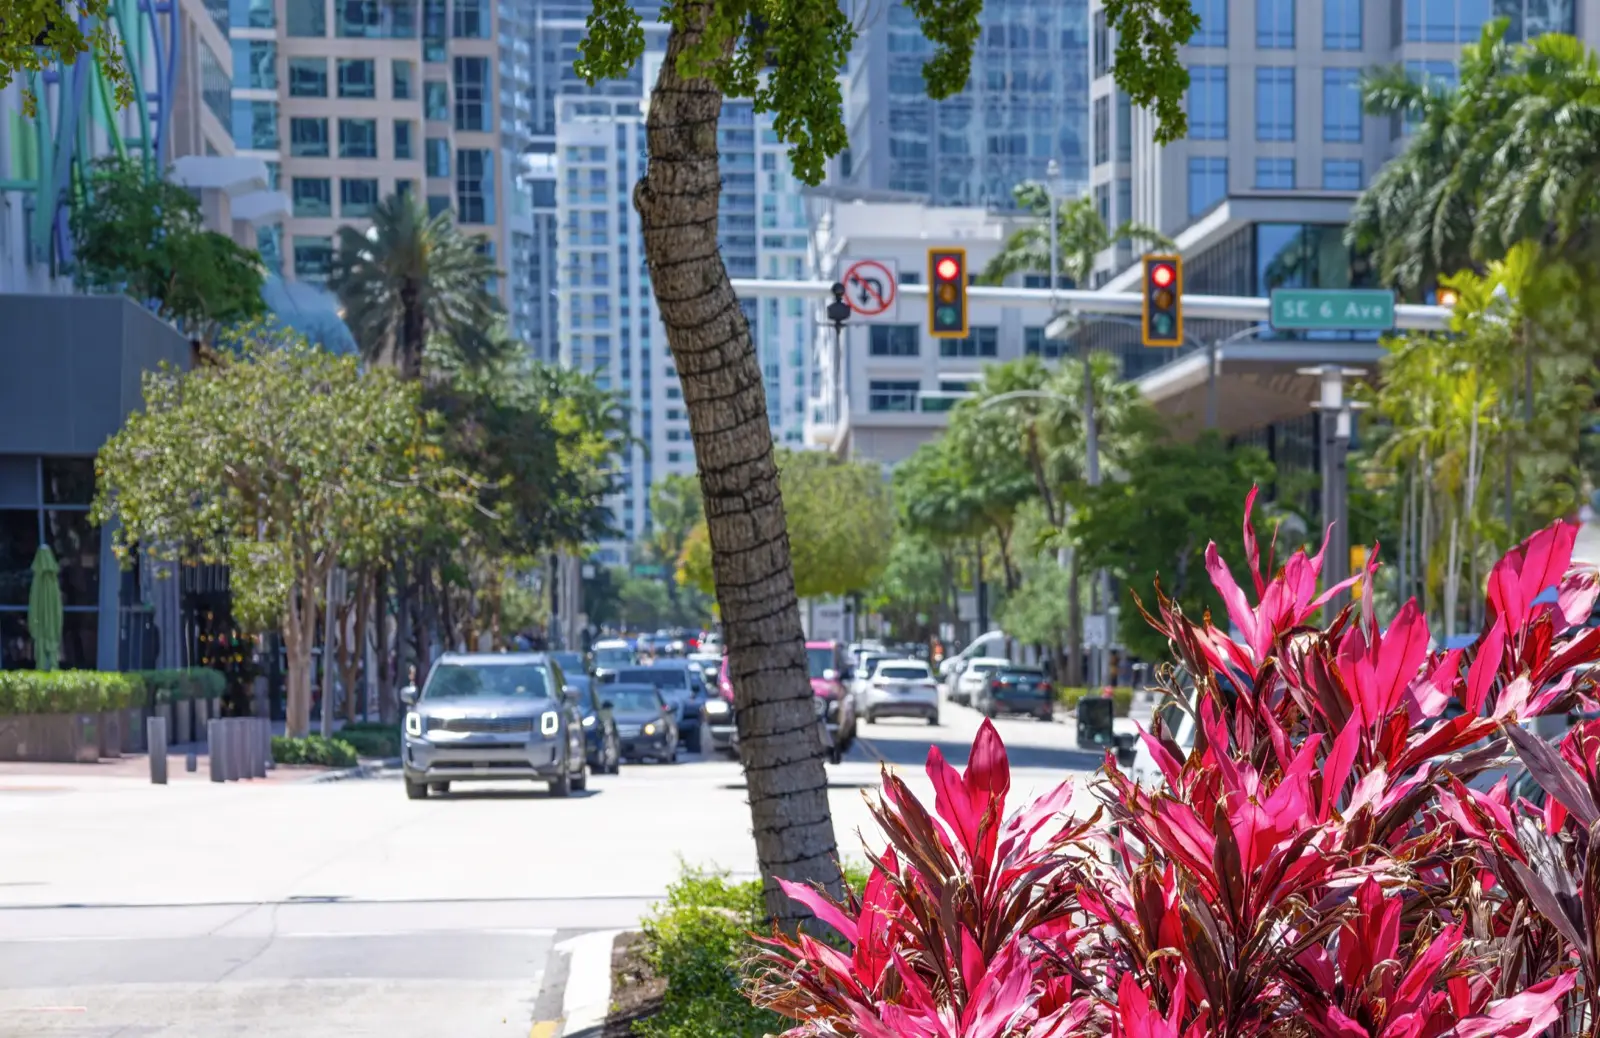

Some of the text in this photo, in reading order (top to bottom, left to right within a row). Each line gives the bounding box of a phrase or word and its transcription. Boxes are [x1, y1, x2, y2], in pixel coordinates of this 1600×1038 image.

[1282, 300, 1384, 318] SE 6 Ave
